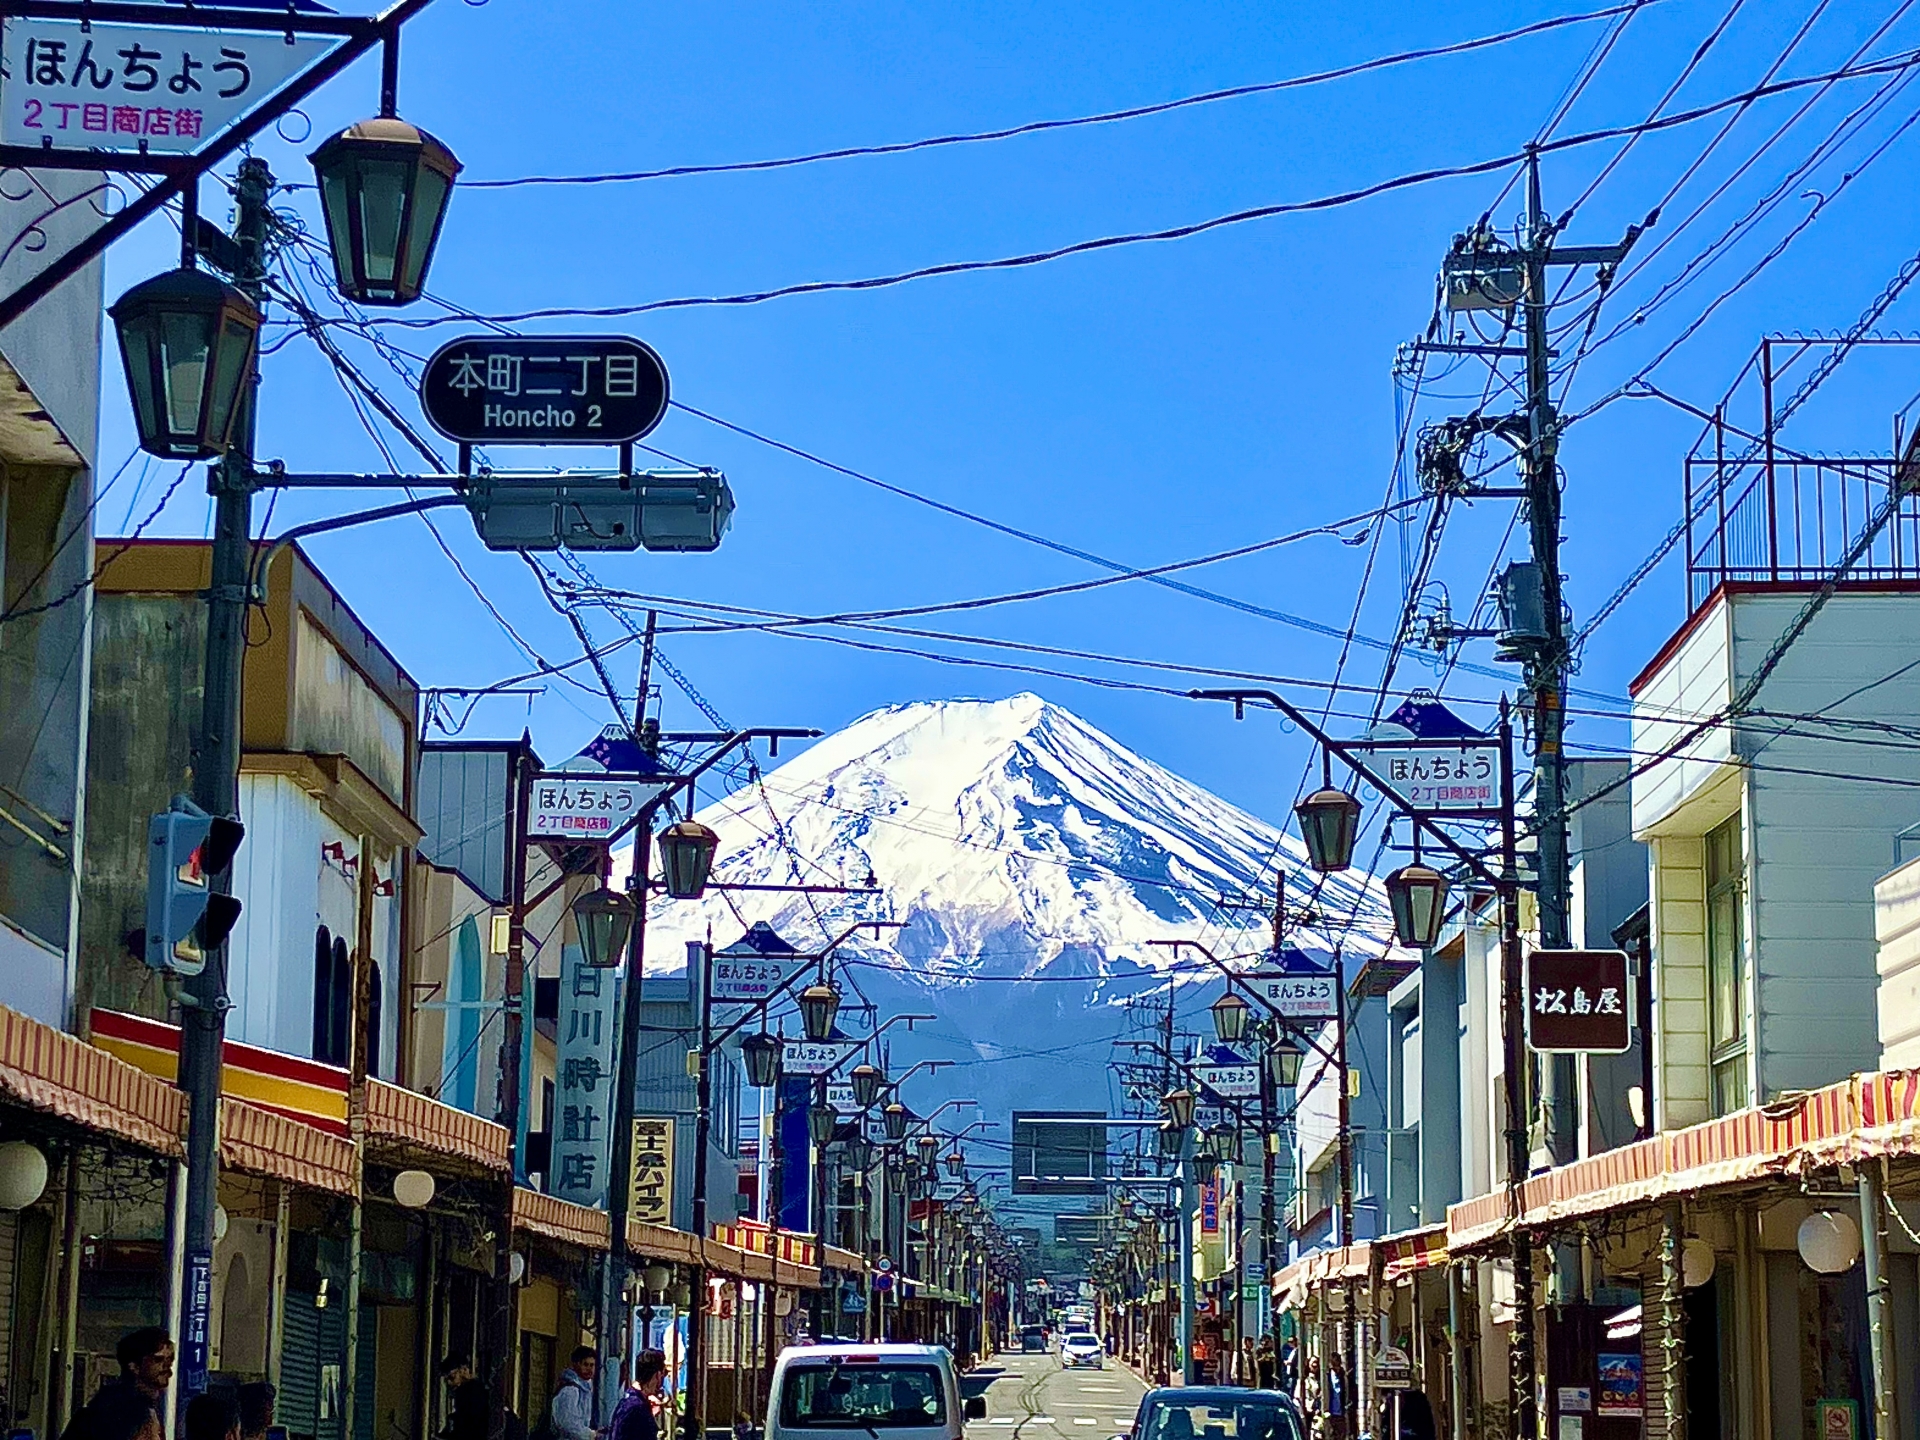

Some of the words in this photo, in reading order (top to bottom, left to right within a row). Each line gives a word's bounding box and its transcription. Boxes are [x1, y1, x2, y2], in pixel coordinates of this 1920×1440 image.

[26, 37, 252, 98] ほんちょう
[23, 99, 203, 138] 2丁目商店街
[448, 353, 638, 397] 本町二丁目
[484, 404, 576, 427] Honcho
[587, 404, 602, 427] 2
[1390, 756, 1491, 780] ほんちょう
[540, 787, 632, 811] ほんちょう
[717, 963, 782, 981] ほんちょう
[1267, 982, 1331, 999] ほんちょう
[1534, 986, 1623, 1015] 松島屋
[559, 962, 602, 1191] 日川時計店
